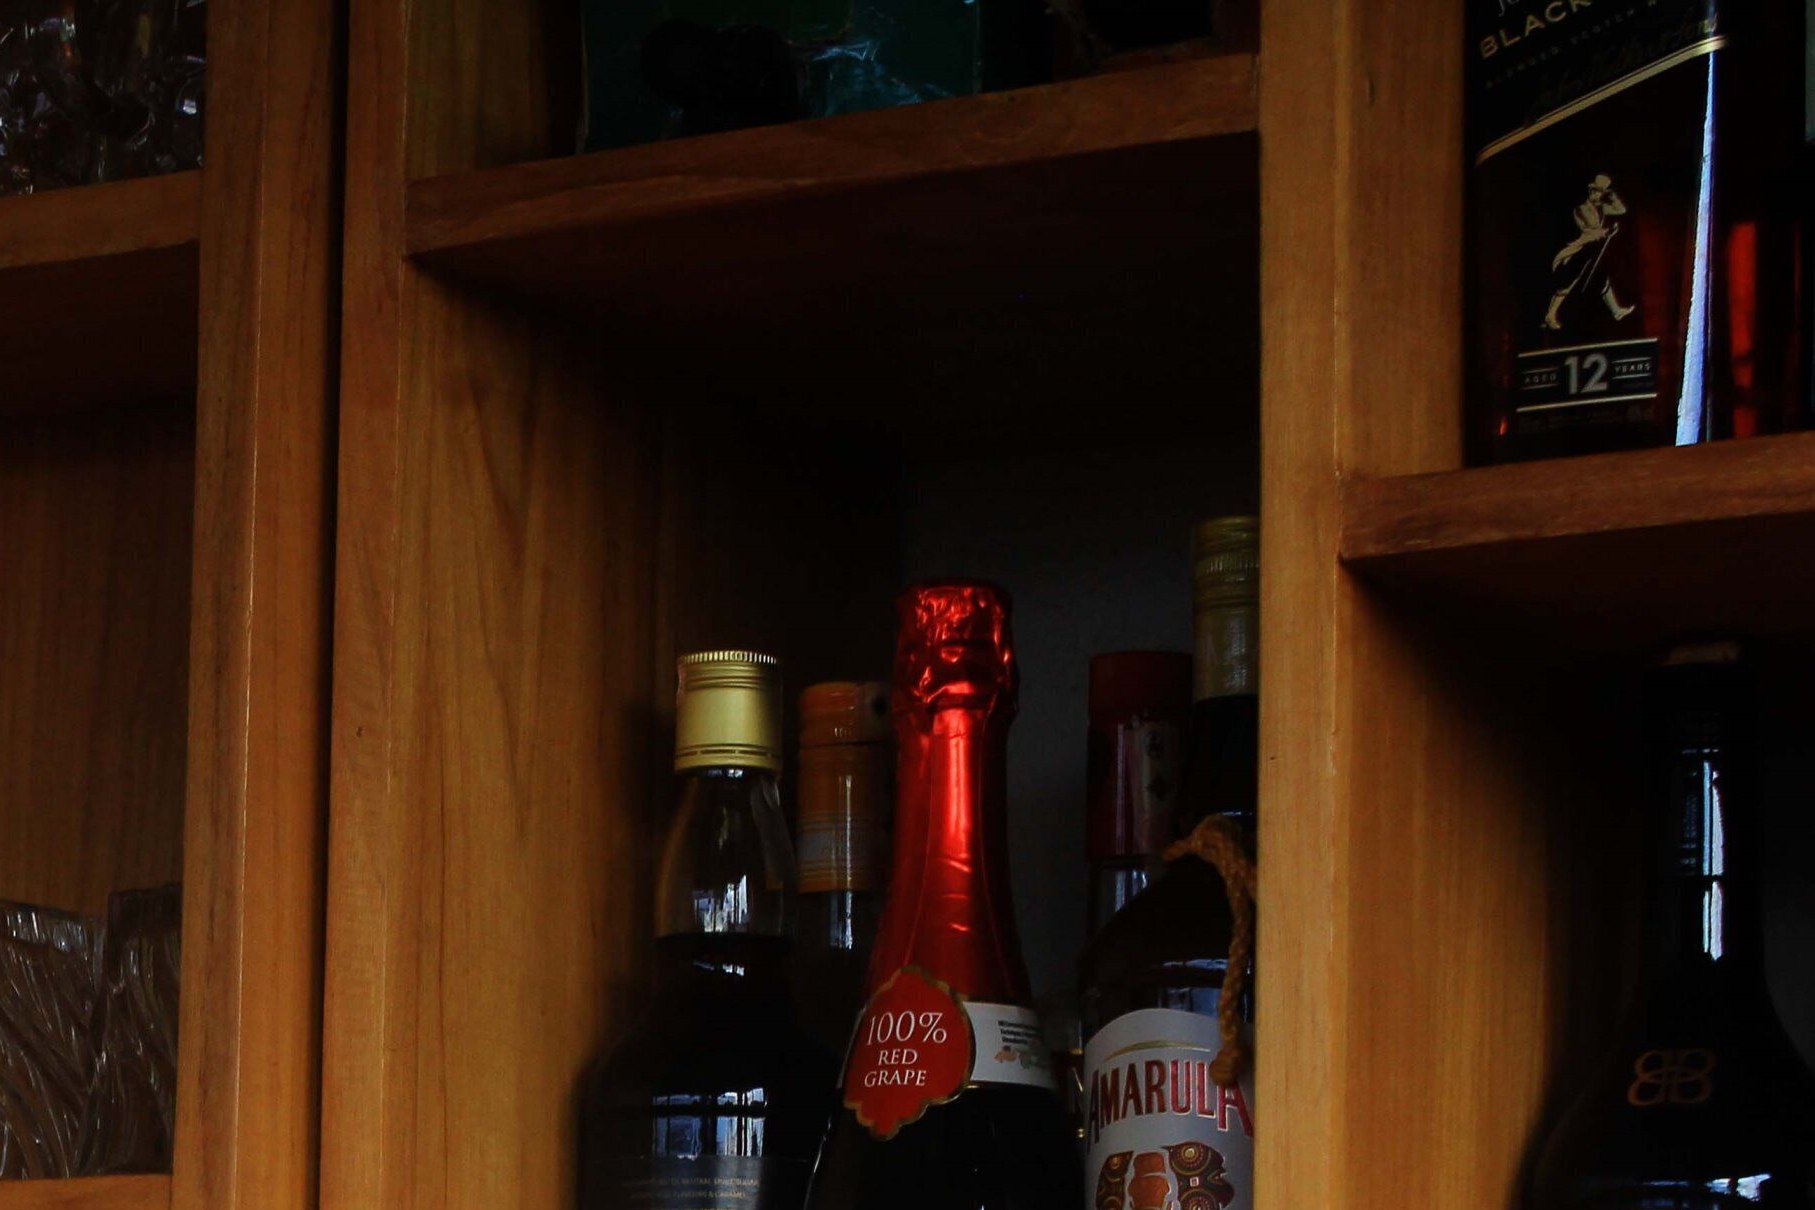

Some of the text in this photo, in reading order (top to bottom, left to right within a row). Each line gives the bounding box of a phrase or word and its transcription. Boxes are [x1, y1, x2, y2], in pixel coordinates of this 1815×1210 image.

[1523, 353, 1651, 396] AGED 12 YEARS
[866, 1010, 947, 1045] 100%
[878, 1048, 918, 1065] RED
[864, 1069, 927, 1087] GRAPE
[1087, 1058, 1254, 1153] AMARULA
